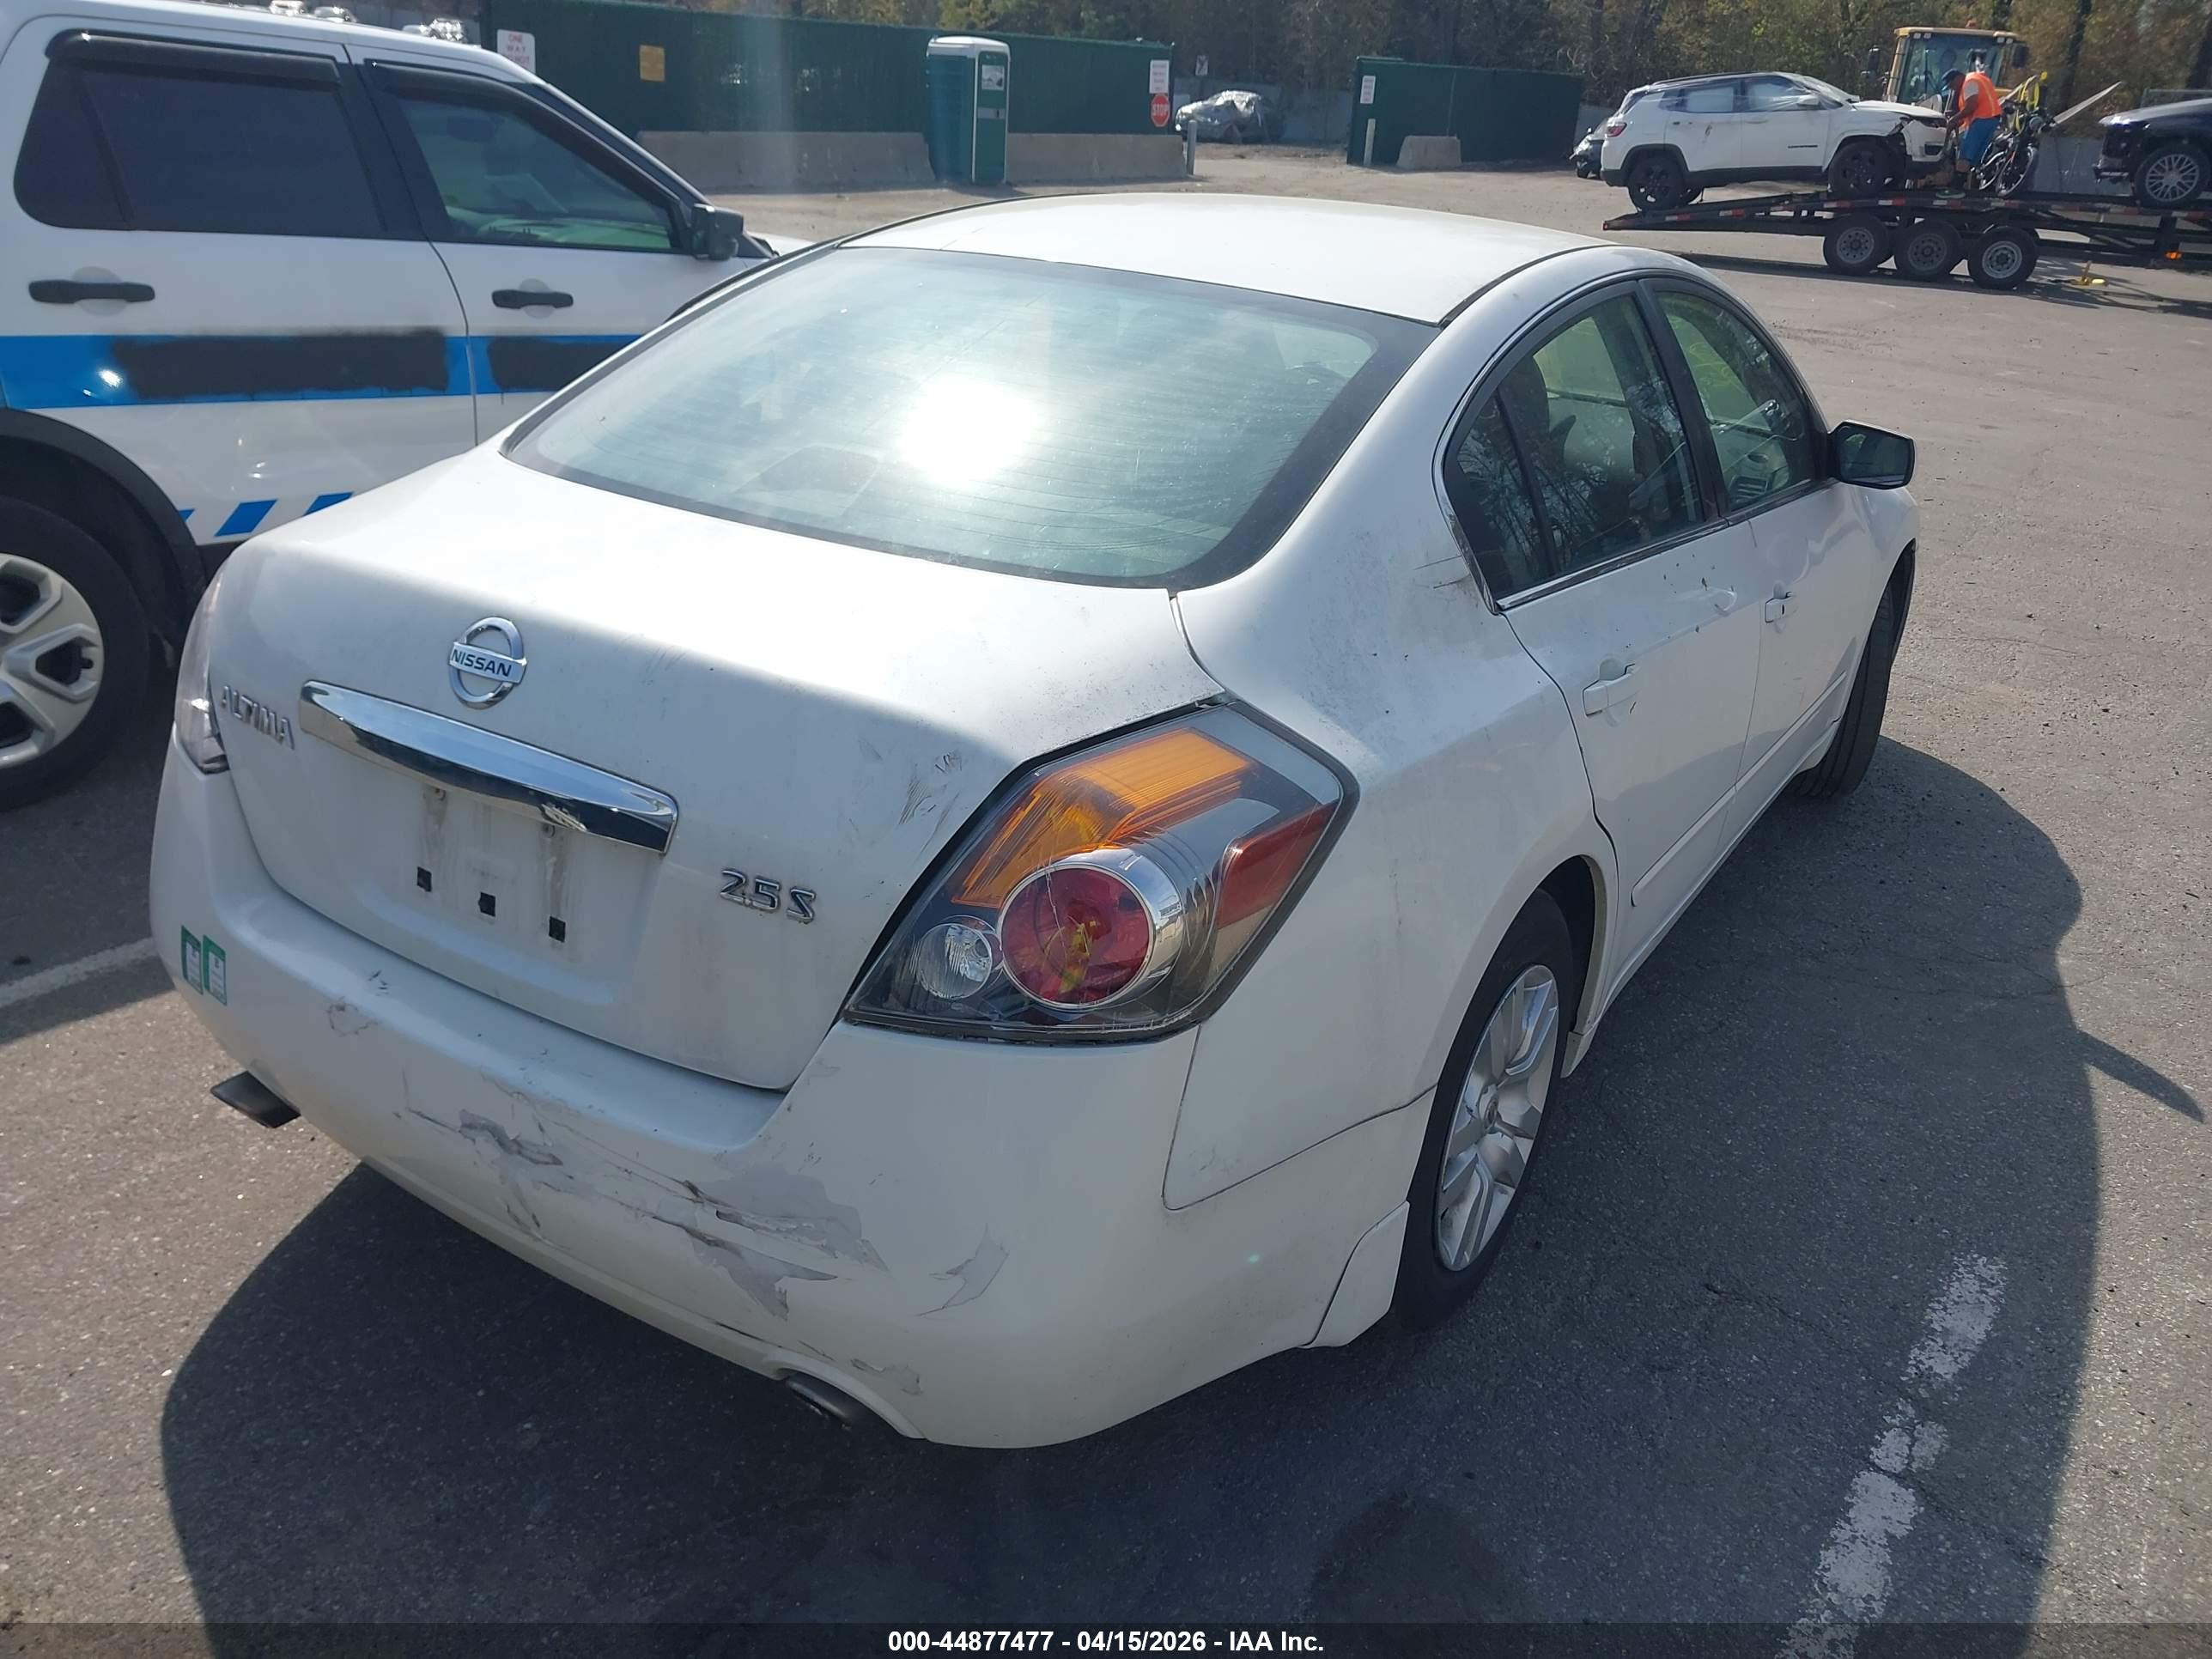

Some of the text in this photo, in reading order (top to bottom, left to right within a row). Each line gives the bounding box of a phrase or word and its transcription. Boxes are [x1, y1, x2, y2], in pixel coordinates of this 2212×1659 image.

[1152, 102, 1170, 116] STOP
[453, 648, 512, 678] NISSAN
[222, 685, 295, 750] ALTIMA
[720, 867, 817, 924] 2.5 S
